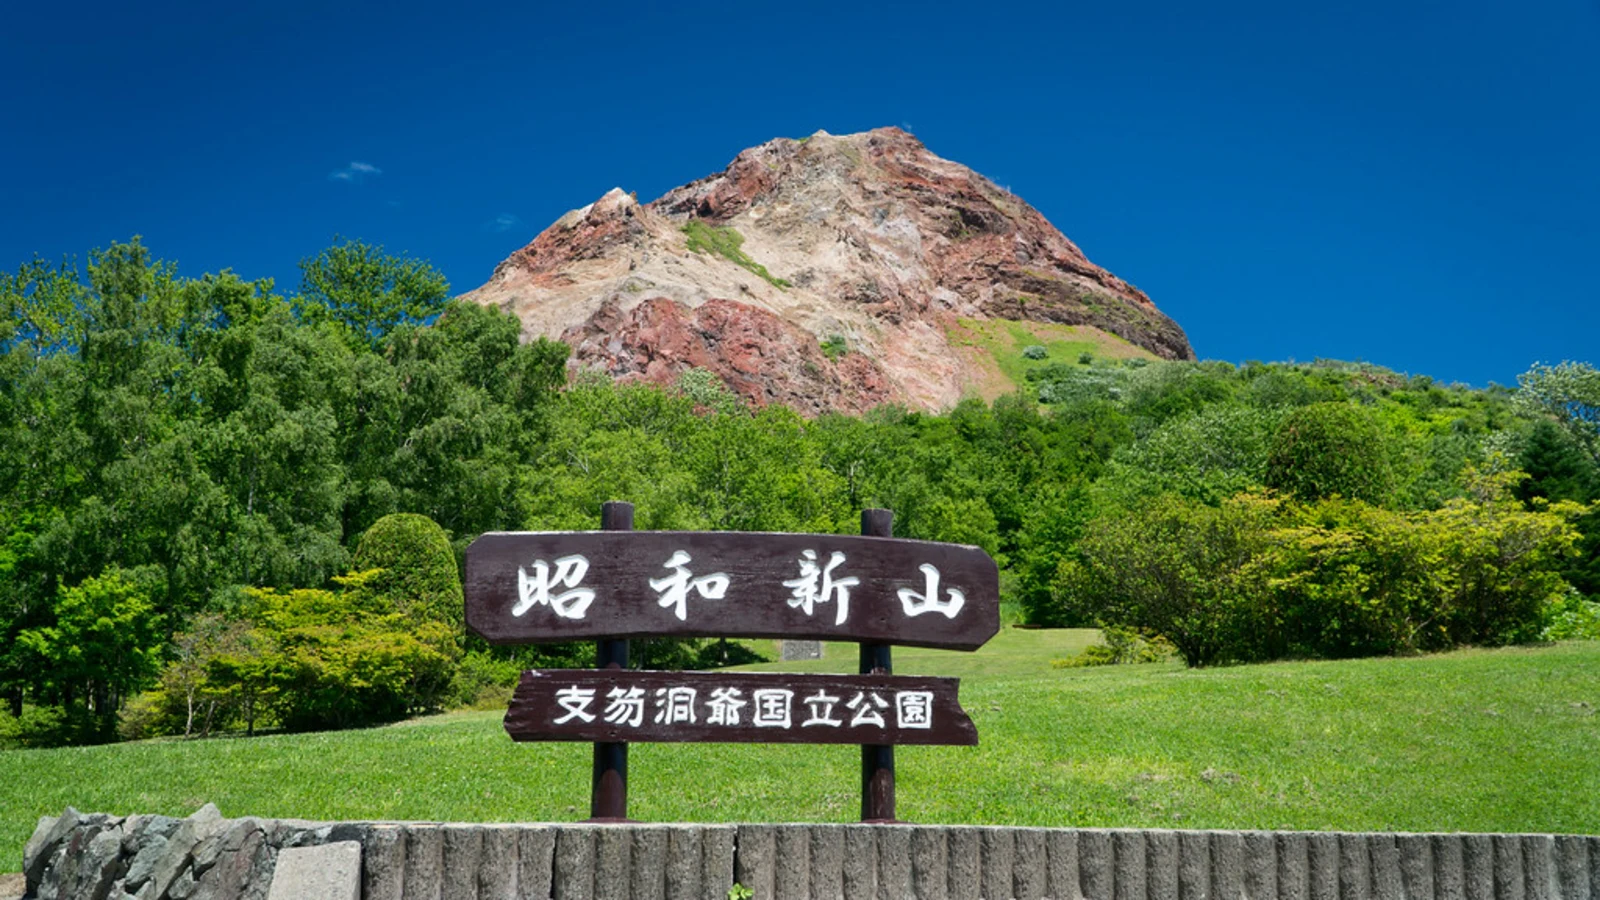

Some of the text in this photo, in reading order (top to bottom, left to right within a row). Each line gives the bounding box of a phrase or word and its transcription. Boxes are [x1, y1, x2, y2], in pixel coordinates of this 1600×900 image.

[511, 549, 966, 626] 昭和新山
[553, 684, 935, 729] 支笏洞爺国立公園
